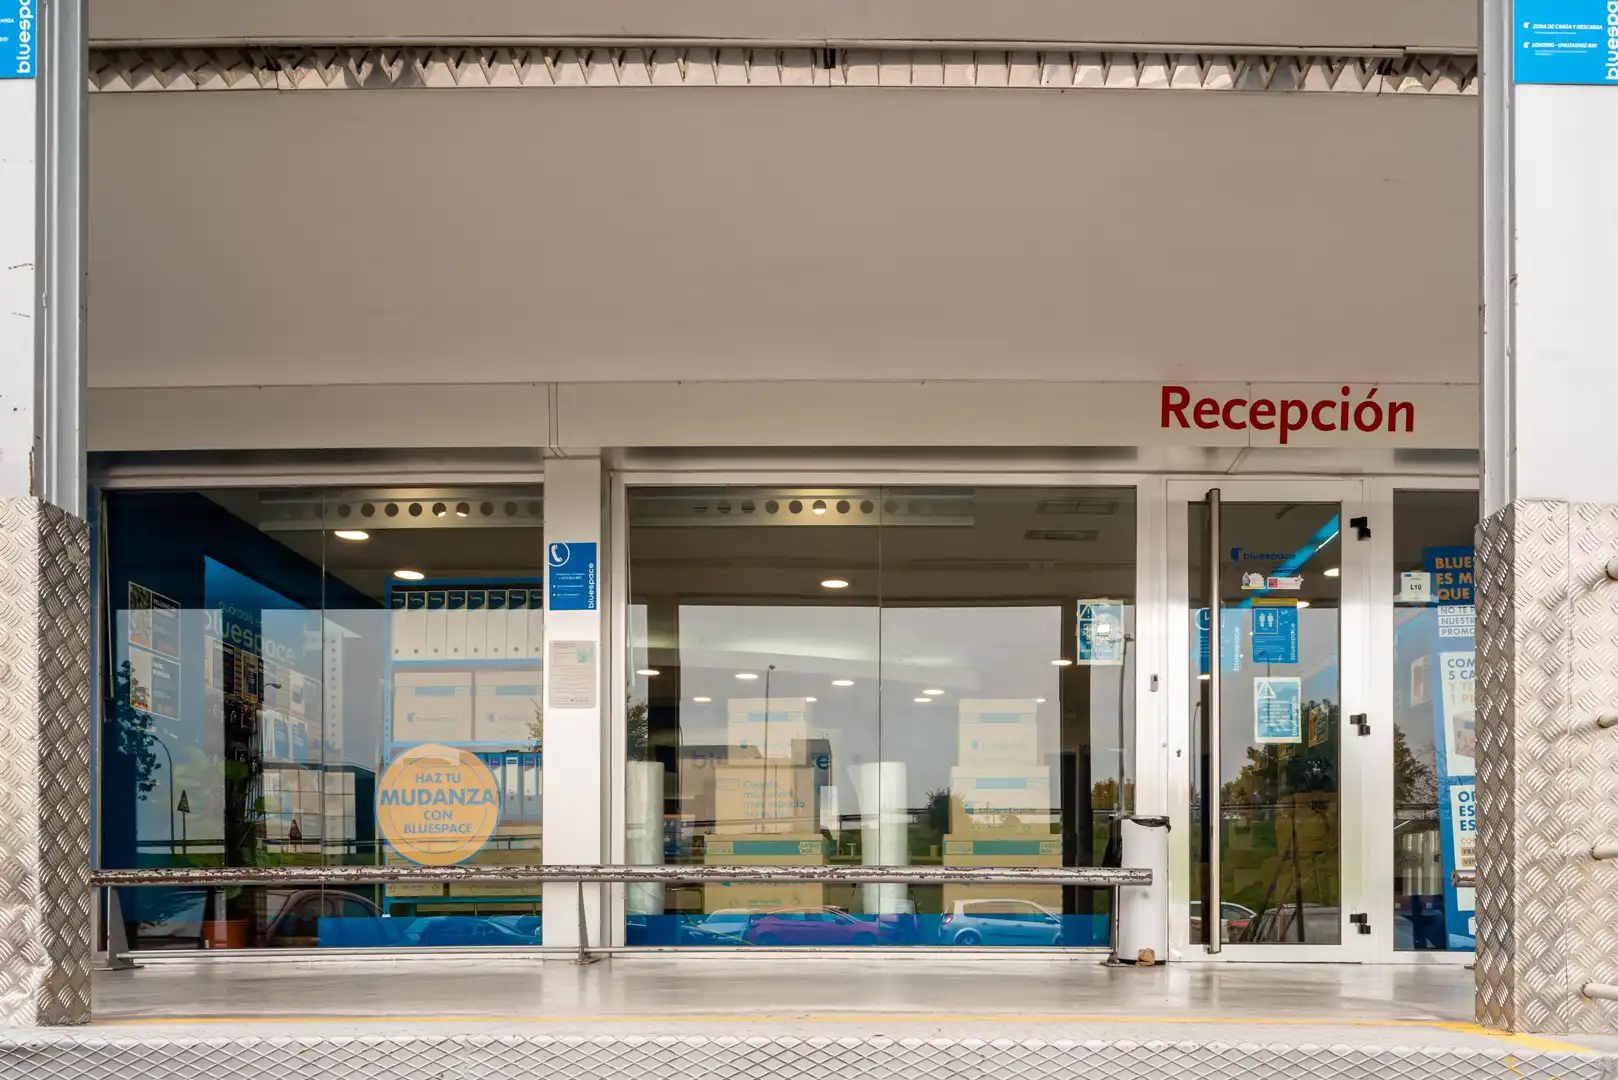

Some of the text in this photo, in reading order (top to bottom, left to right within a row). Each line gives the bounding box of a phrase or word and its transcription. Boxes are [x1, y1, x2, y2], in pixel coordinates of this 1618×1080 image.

[1161, 385, 1415, 444] Recepción
[1243, 551, 1297, 561] bluespace
[1435, 556, 1475, 569] BLUE
[1436, 572, 1453, 585] ES
[588, 562, 596, 609] bluespace
[1437, 588, 1470, 601] QUE
[1440, 606, 1455, 614] NO
[1457, 606, 1468, 614] TE
[415, 772, 461, 783] HAZ TU
[380, 788, 496, 806] MUDANZA
[423, 810, 453, 820] CON
[1459, 805, 1475, 817] ES
[404, 823, 472, 834] BLUESPACE
[1460, 819, 1475, 831] ES
